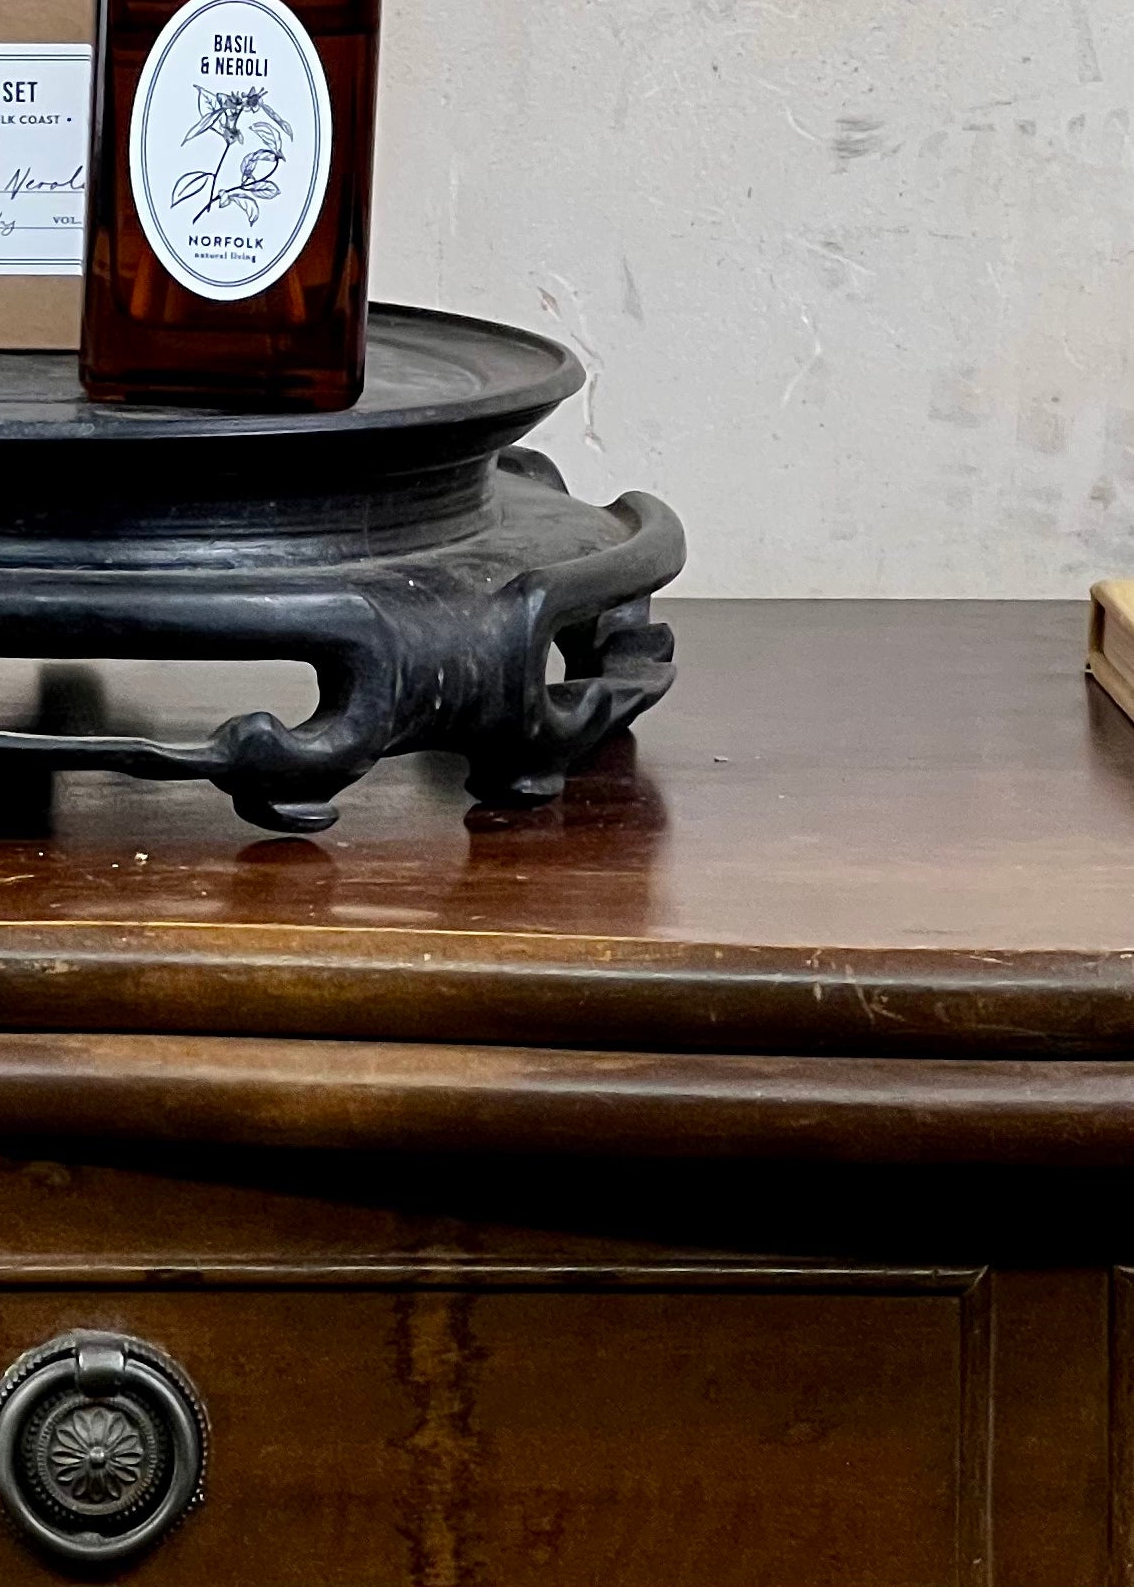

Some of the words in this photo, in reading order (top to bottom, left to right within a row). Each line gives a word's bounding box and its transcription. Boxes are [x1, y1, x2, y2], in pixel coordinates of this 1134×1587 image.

[214, 34, 257, 54] BASIL
[200, 56, 210, 74] &
[215, 57, 268, 77] NEROLI
[2, 81, 38, 103] SET
[19, 115, 61, 125] COAST
[188, 235, 264, 250] NORFOLK
[194, 252, 228, 260] natural
[230, 252, 256, 263] living
